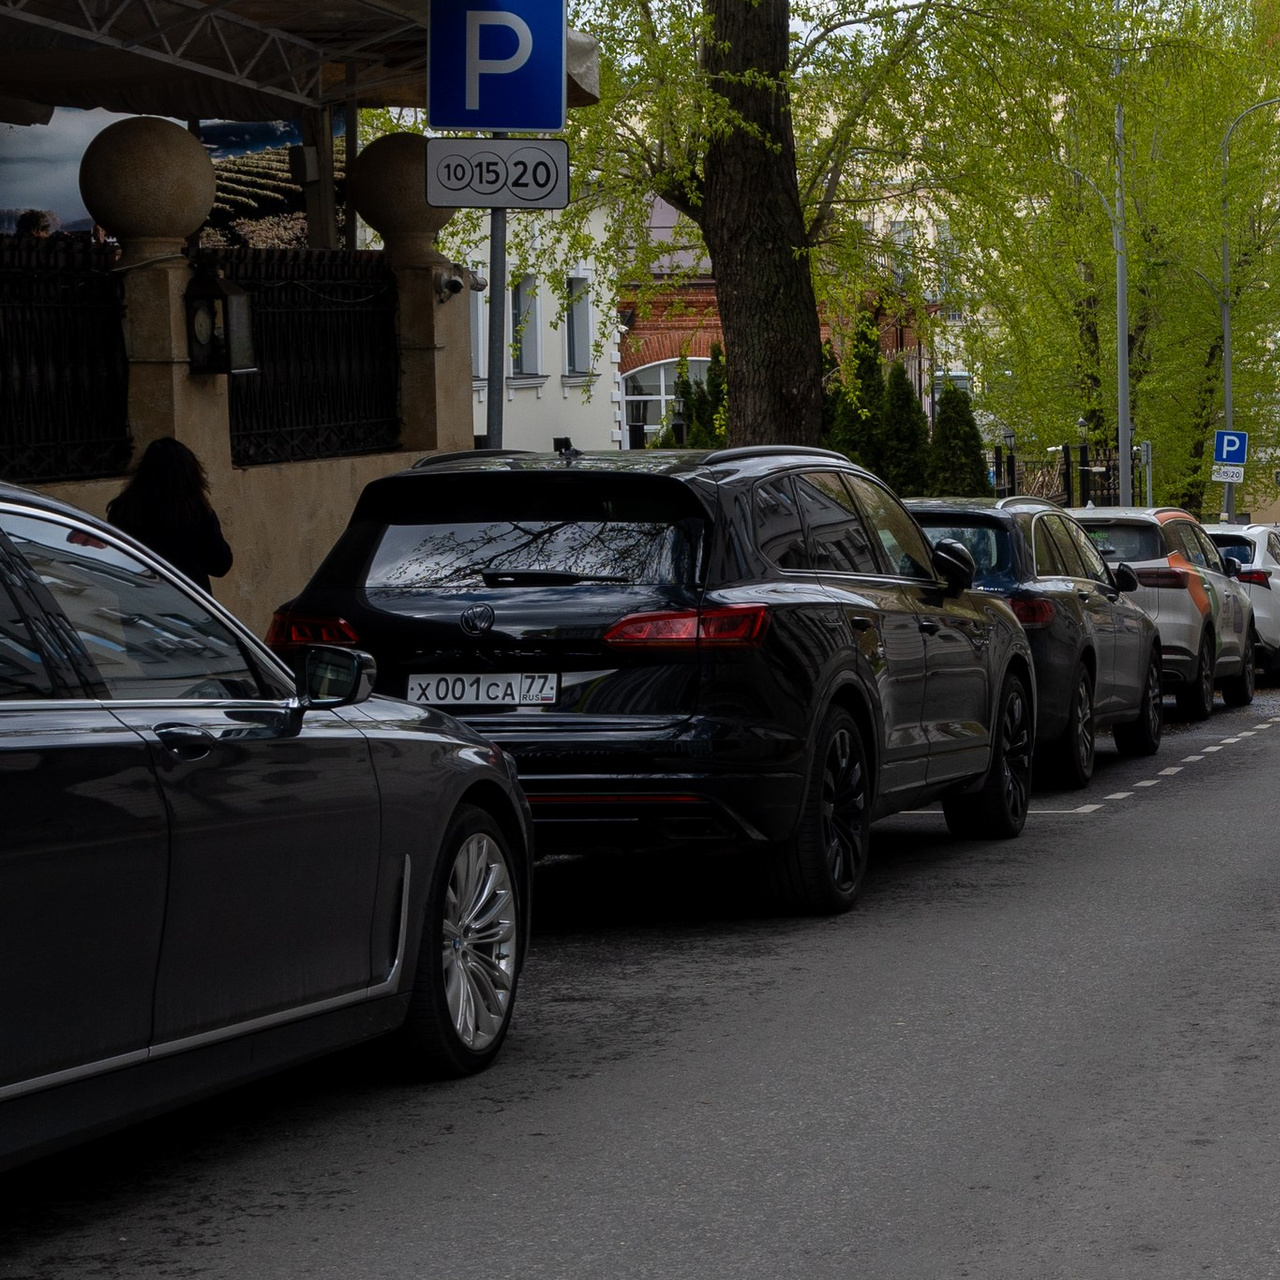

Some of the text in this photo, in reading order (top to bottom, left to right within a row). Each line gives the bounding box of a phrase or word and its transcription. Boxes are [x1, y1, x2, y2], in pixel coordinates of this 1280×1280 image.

[466, 11, 533, 110] P
[443, 160, 551, 188] 10 15 20
[1222, 435, 1240, 459] P
[1230, 470, 1240, 479] 20
[524, 675, 549, 693] 77
[522, 694, 540, 702] RUS
